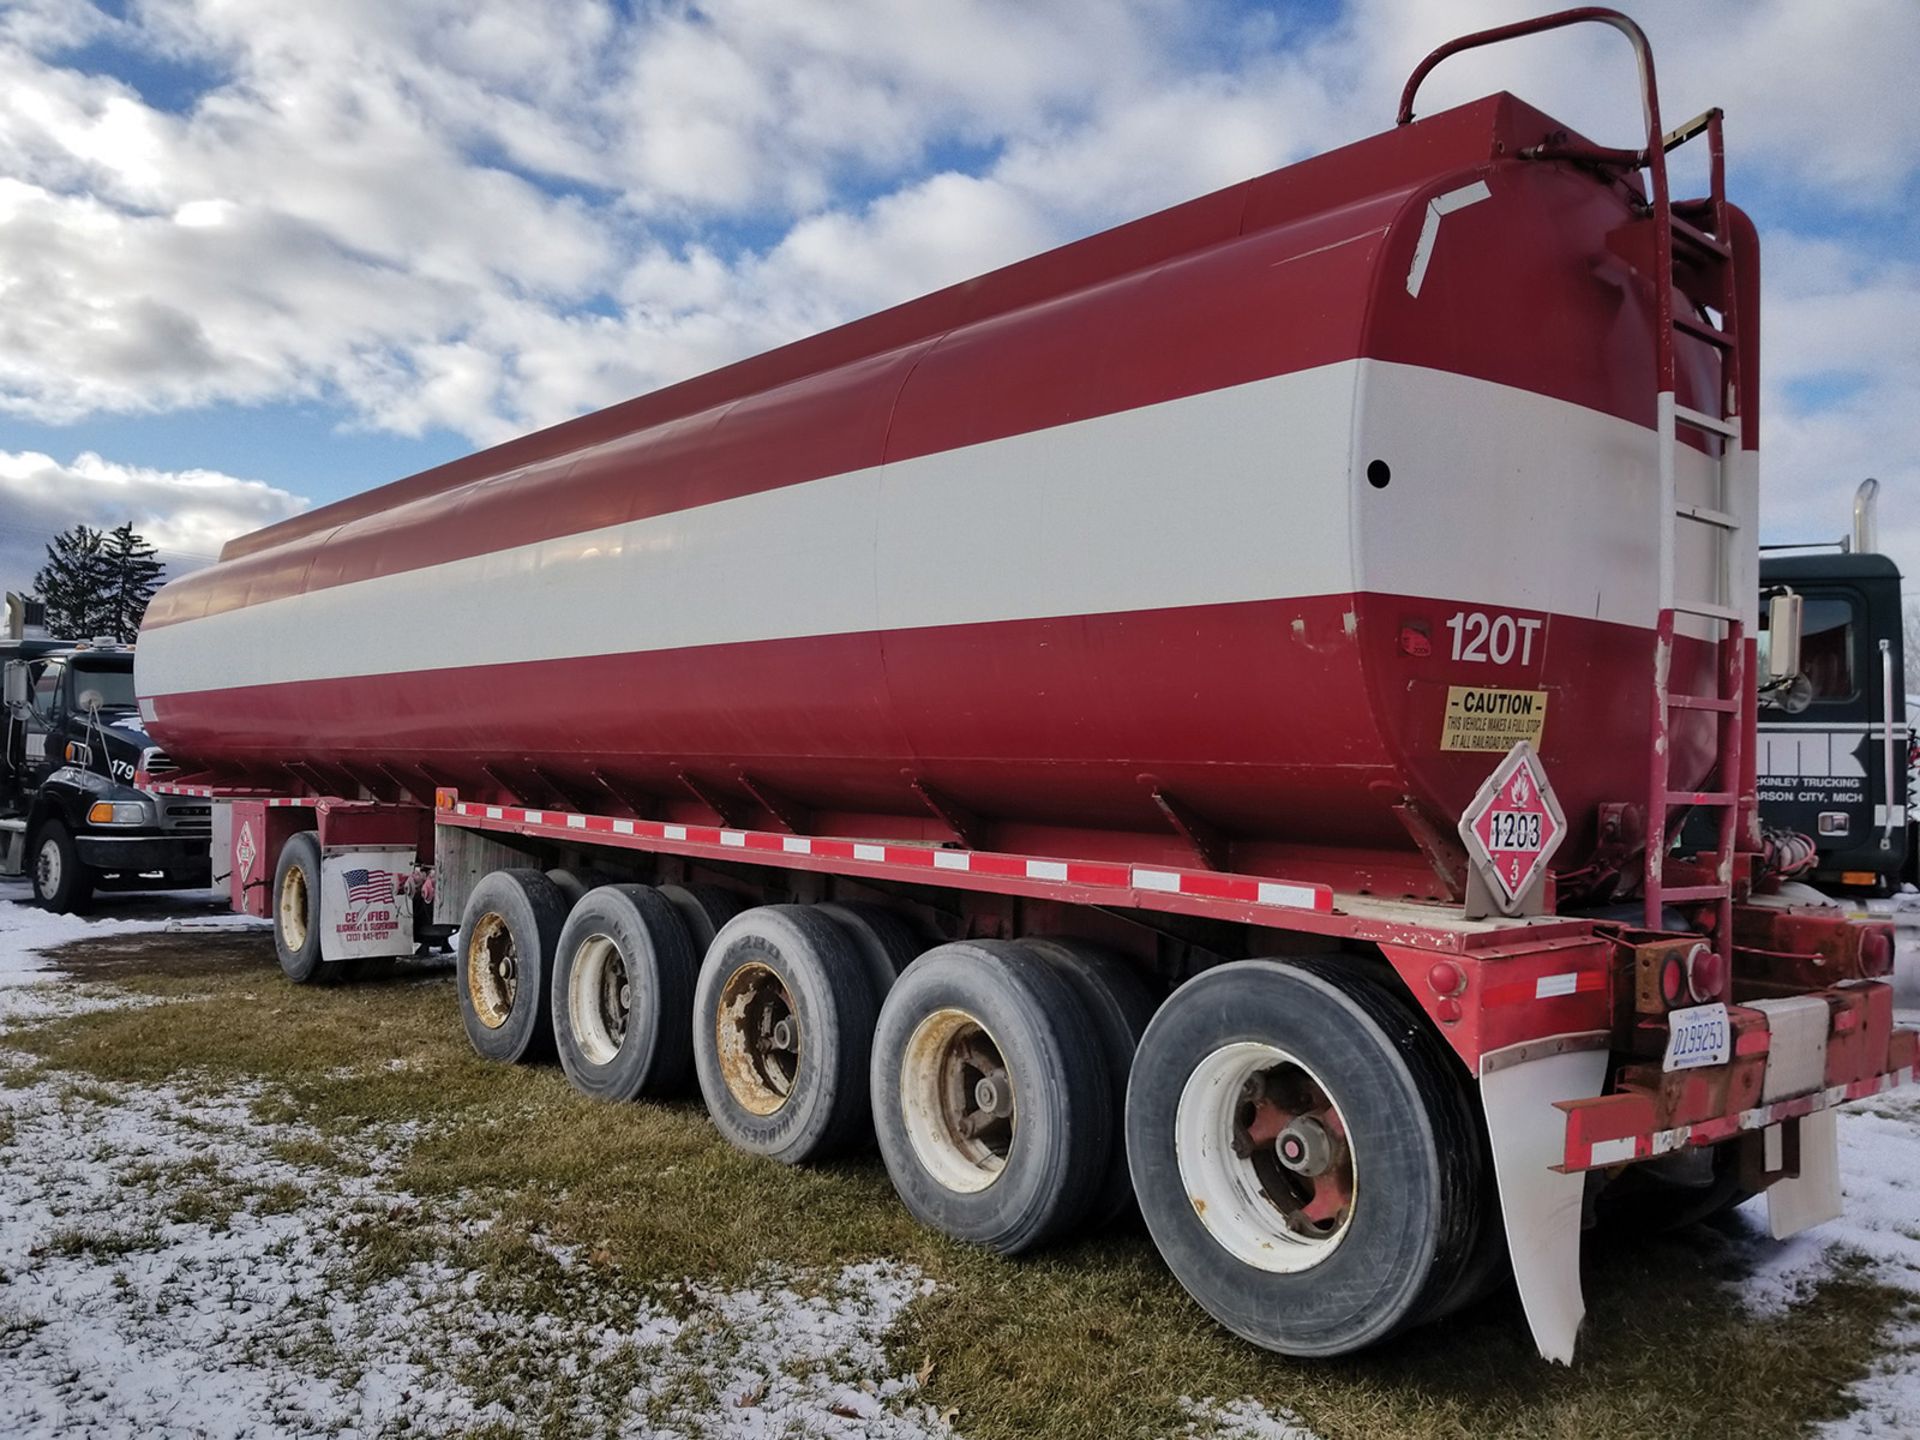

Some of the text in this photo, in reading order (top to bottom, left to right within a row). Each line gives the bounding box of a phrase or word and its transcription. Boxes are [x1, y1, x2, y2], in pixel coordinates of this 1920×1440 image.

[1446, 612, 1542, 666] 120T
[1463, 691, 1533, 714] CAUTION
[1448, 716, 1461, 730] THIS
[1462, 716, 1487, 731] VEHICLE
[1487, 717, 1507, 732] MAKES
[1512, 719, 1525, 732] FULL
[1526, 720, 1541, 733] STOP
[1451, 734, 1460, 747] AT
[1460, 735, 1470, 748] ALL
[1471, 735, 1501, 749] RAILROAD
[112, 759, 135, 779] 179
[1756, 777, 1860, 788] cKINLEY TRUCKING
[1756, 791, 1863, 803] ARSON CITY, MICH
[1493, 813, 1541, 848] 1203
[1510, 864, 1519, 881] 3
[1673, 1021, 1724, 1055] D199253
